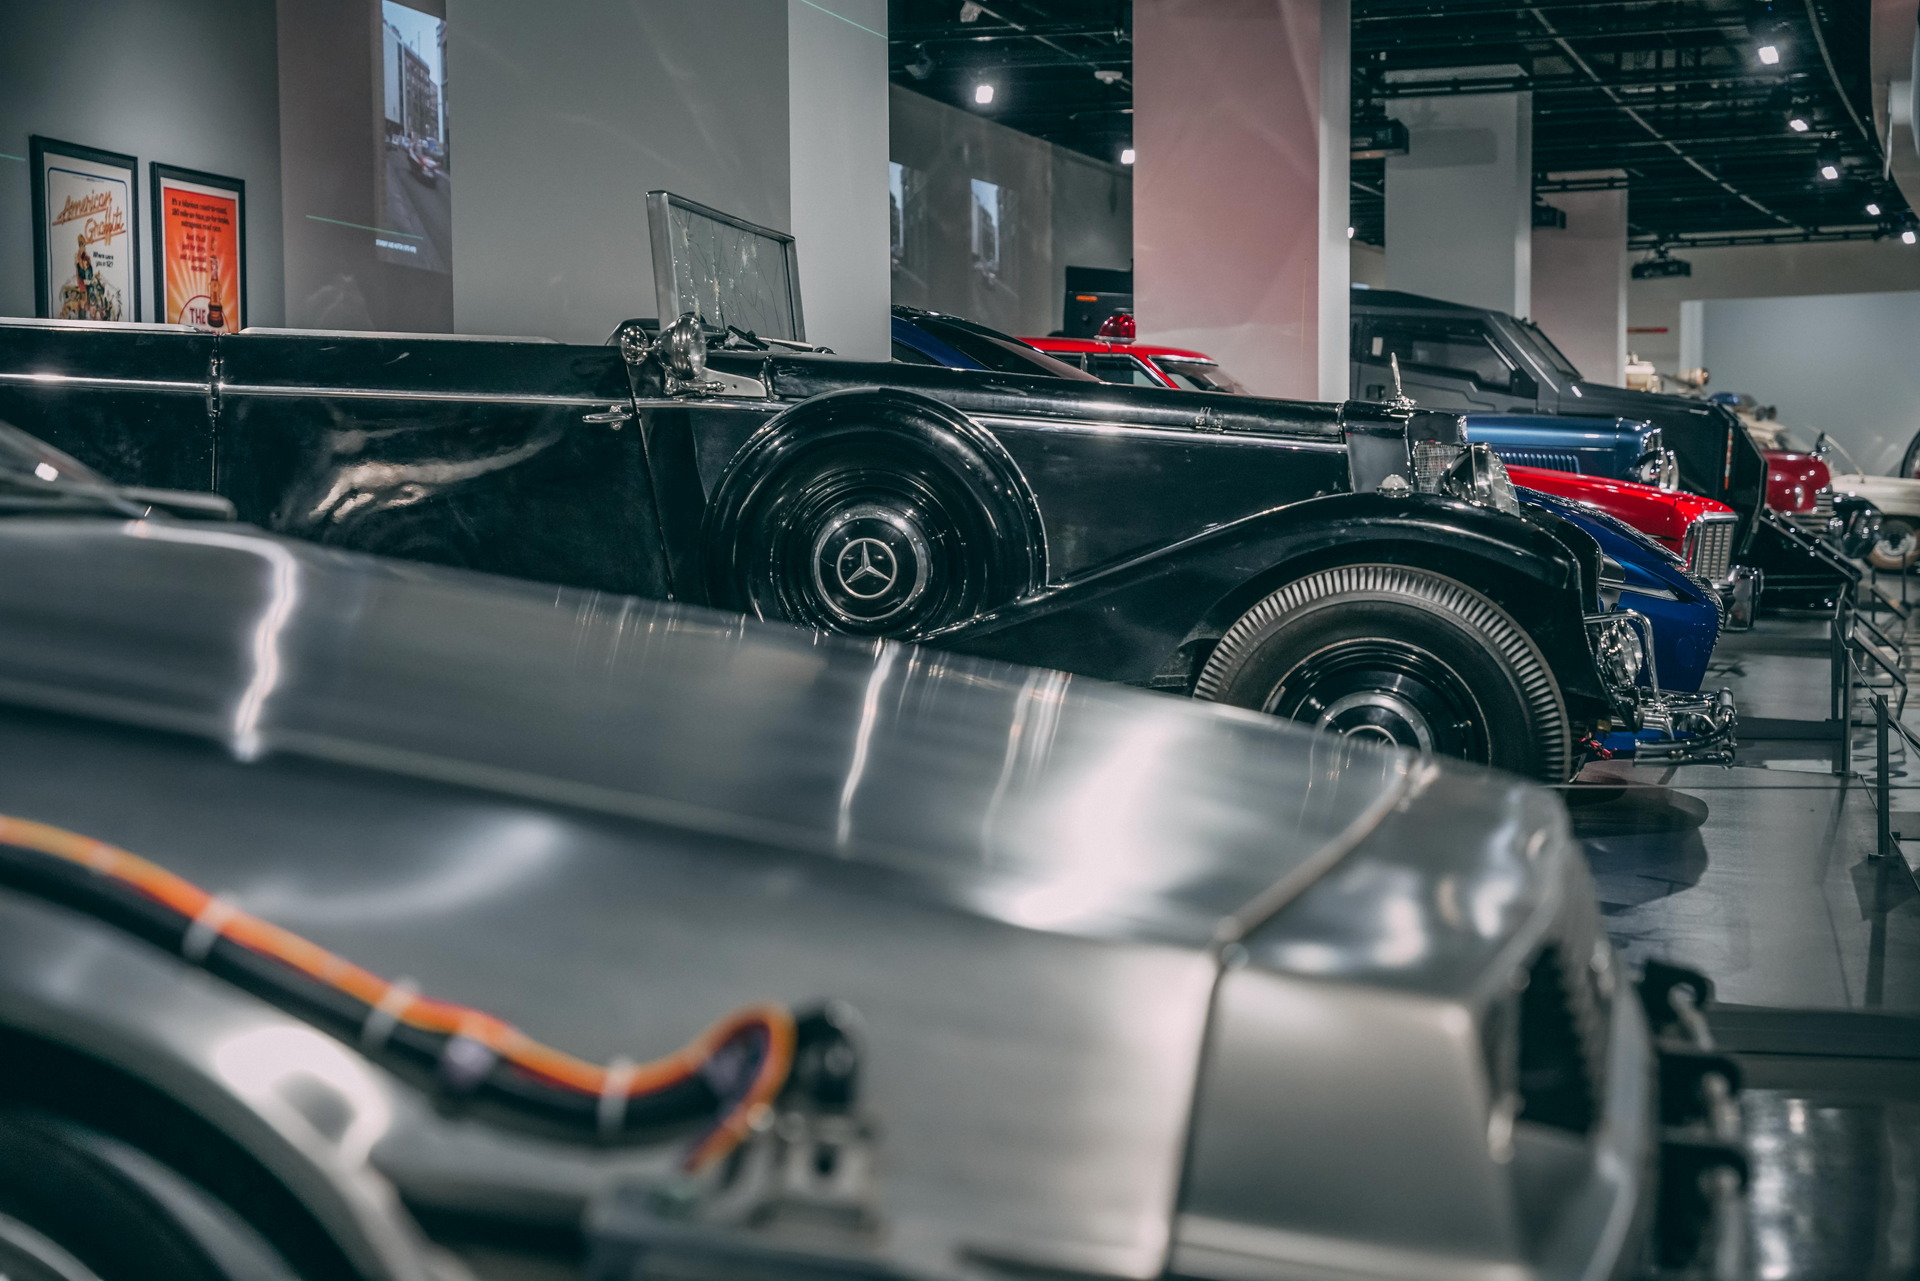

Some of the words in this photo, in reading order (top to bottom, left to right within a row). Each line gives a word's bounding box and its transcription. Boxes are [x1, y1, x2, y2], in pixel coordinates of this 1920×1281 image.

[55, 190, 112, 225] American
[84, 206, 125, 246] Graffiti
[189, 307, 206, 325] THE
